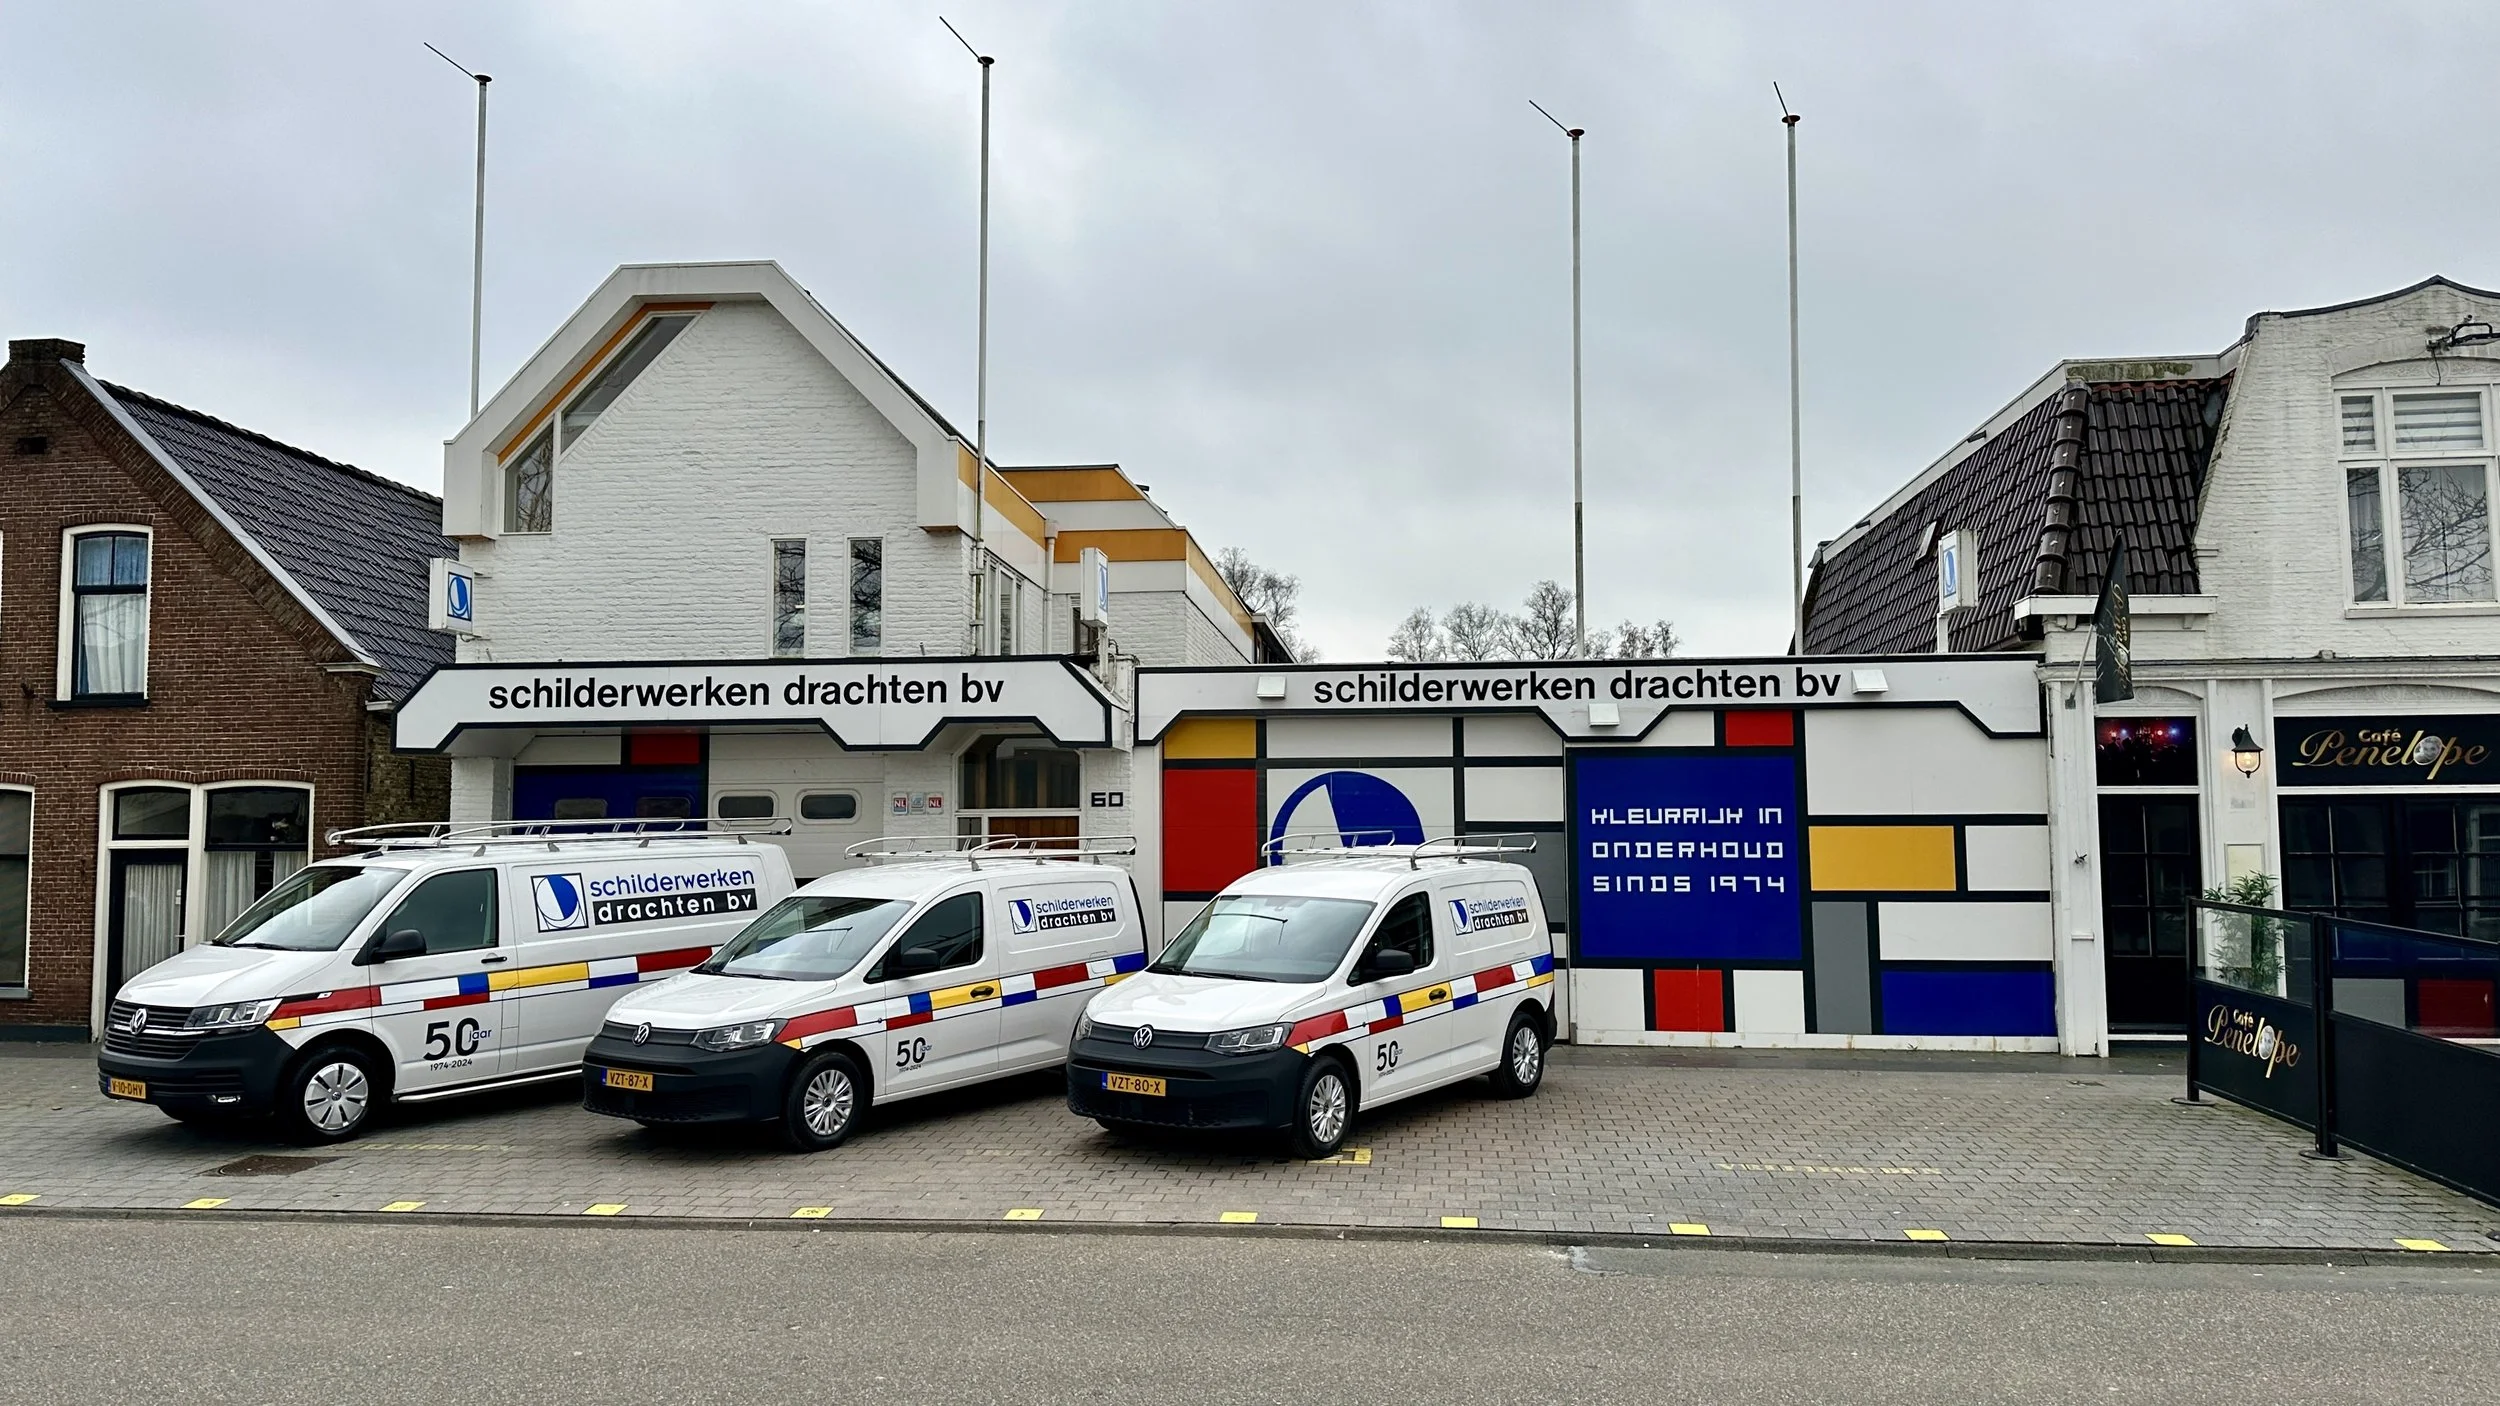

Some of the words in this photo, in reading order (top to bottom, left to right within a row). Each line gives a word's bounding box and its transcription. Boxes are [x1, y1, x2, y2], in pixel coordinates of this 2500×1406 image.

[488, 676, 770, 709] schilderwerken
[784, 674, 947, 705] drachten
[961, 672, 1004, 703] bv
[1314, 671, 1595, 703] schilderwerken
[1610, 668, 1781, 699] drachten
[1796, 667, 1841, 697] bv
[2358, 728, 2402, 746] Café
[2292, 729, 2491, 780] Penelope
[894, 799, 906, 808] NL
[929, 799, 941, 808] NL
[1091, 792, 1124, 807] 60
[1591, 808, 1743, 824] KLEURRIJK
[1758, 808, 1782, 824] IN
[1592, 842, 1784, 858] ONDERHOUD
[589, 869, 755, 897] schilderwerken
[1593, 876, 1691, 892] SINDS
[1710, 876, 1785, 893] 1974
[597, 897, 716, 922] drachten
[727, 893, 752, 910] bv
[1035, 896, 1114, 914] schilderwerken
[1040, 913, 1097, 929] drachten
[1100, 910, 1114, 922] bv
[1474, 913, 1515, 930] drachten
[2233, 1008, 2254, 1031] Café
[423, 1017, 480, 1061] 50
[468, 1029, 492, 1043] jaar
[2204, 1004, 2301, 1079] Penelope
[895, 1036, 927, 1067] 50
[1376, 1040, 1399, 1071] 50
[430, 1058, 473, 1072] 1974-2024
[610, 1072, 649, 1089] VZT-87-X
[1111, 1075, 1161, 1094] VZT-80-X
